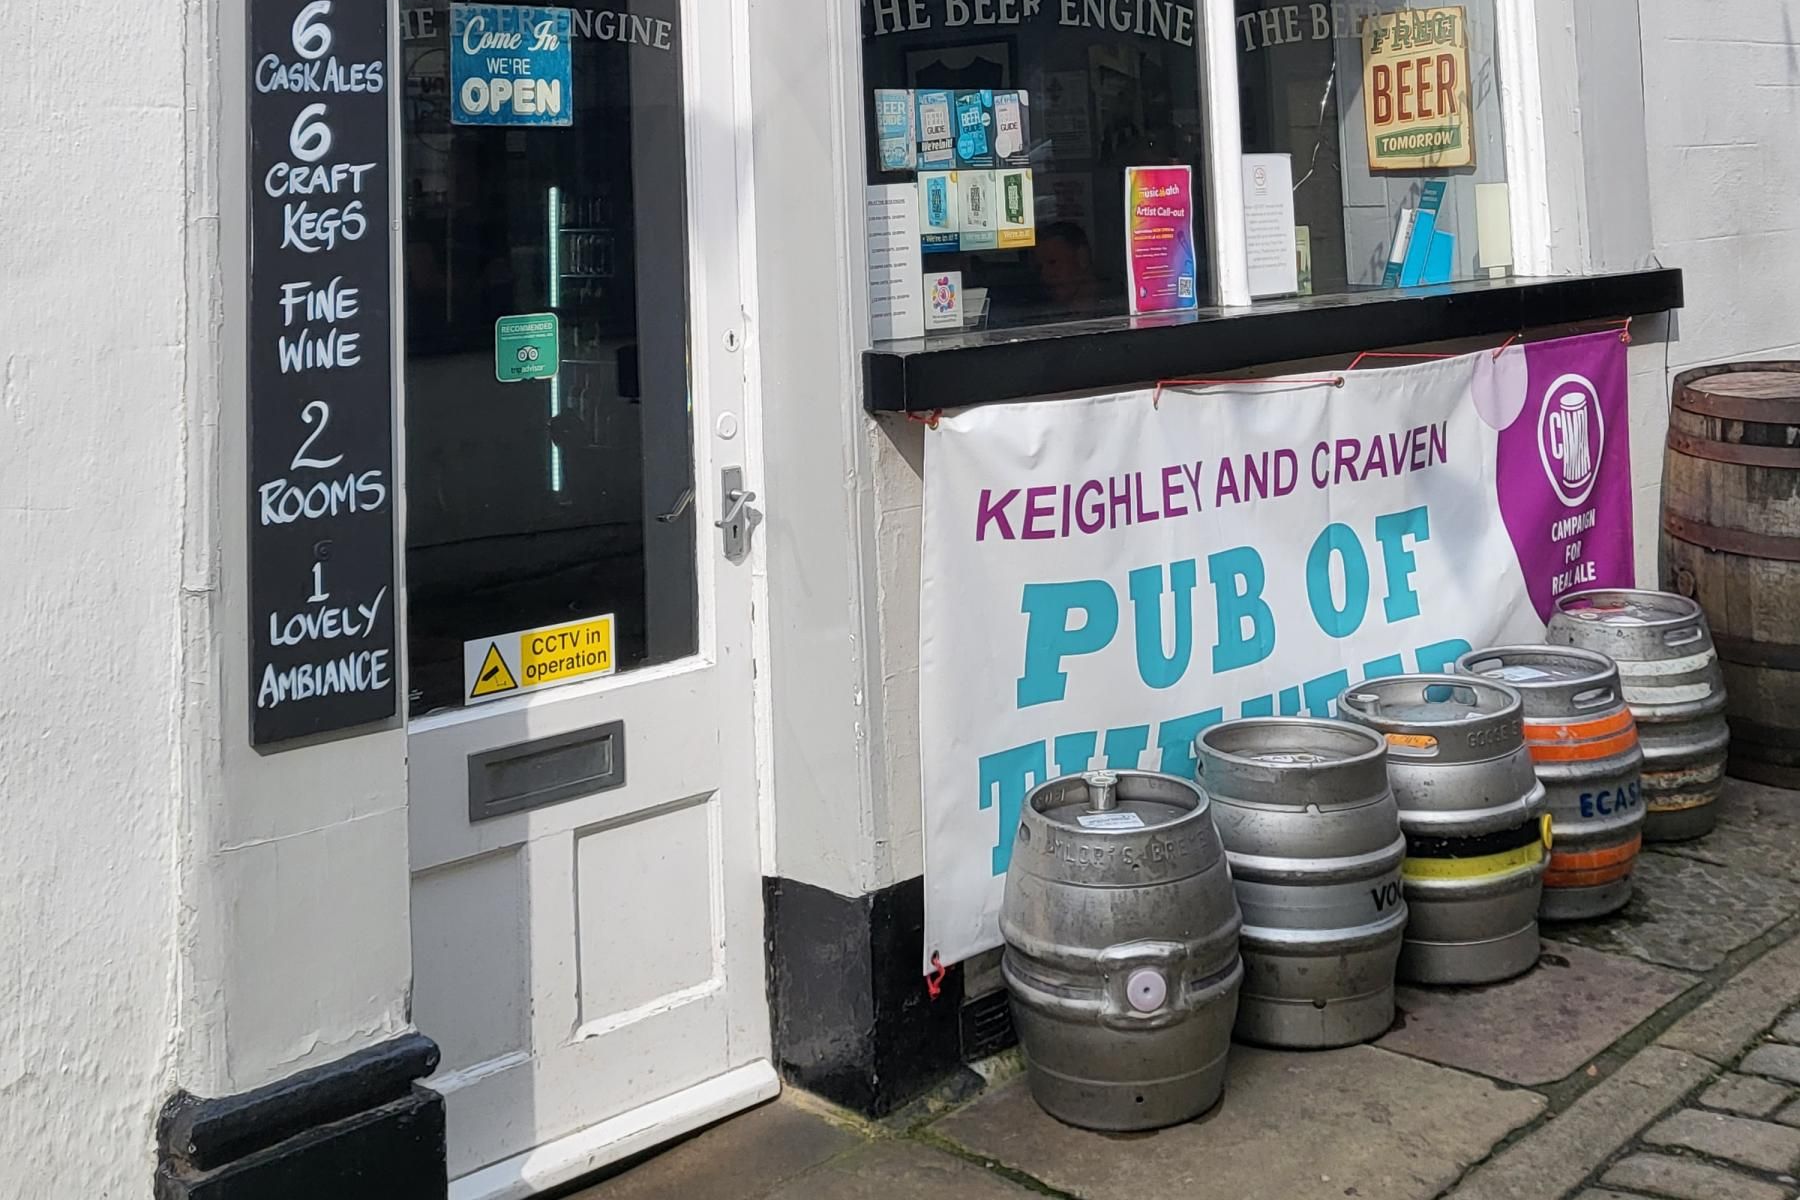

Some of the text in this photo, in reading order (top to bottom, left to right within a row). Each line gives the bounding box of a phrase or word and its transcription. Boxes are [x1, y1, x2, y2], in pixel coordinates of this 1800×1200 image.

[291, 0, 333, 59] 6
[400, 7, 437, 41] HE
[553, 8, 673, 50] ENGINE
[462, 15, 560, 55] Come In
[1236, 4, 1303, 52] THE
[1309, 2, 1387, 40] BEER
[255, 52, 384, 93] CASK ALES
[486, 57, 531, 75] WE'RE
[461, 77, 562, 116] OPEN
[1373, 53, 1457, 126] BEER
[289, 103, 332, 162] 6
[1382, 130, 1453, 153] TOMORROW
[264, 161, 377, 198] CRAFT
[280, 200, 367, 253] KEGS
[1136, 206, 1185, 218] Artist Call-out
[279, 276, 360, 326] FINE
[501, 322, 553, 333] RECOMMENDED
[278, 327, 361, 374] WINE
[289, 400, 345, 471] 2
[258, 469, 386, 526] ROOMS
[975, 420, 1449, 543] KEIGHLEY AND CRAVEN
[1551, 508, 1596, 543] CAMPAIGN
[1565, 540, 1582, 564] FOR
[307, 561, 330, 603] 1
[1552, 561, 1597, 596] REAL ALE
[270, 585, 388, 646] LOVELY
[1016, 545, 1277, 710] PUB
[1305, 505, 1431, 640] OF
[531, 628, 601, 656] CCTV in
[257, 649, 391, 708] AMBIANCE
[526, 650, 607, 681] operation
